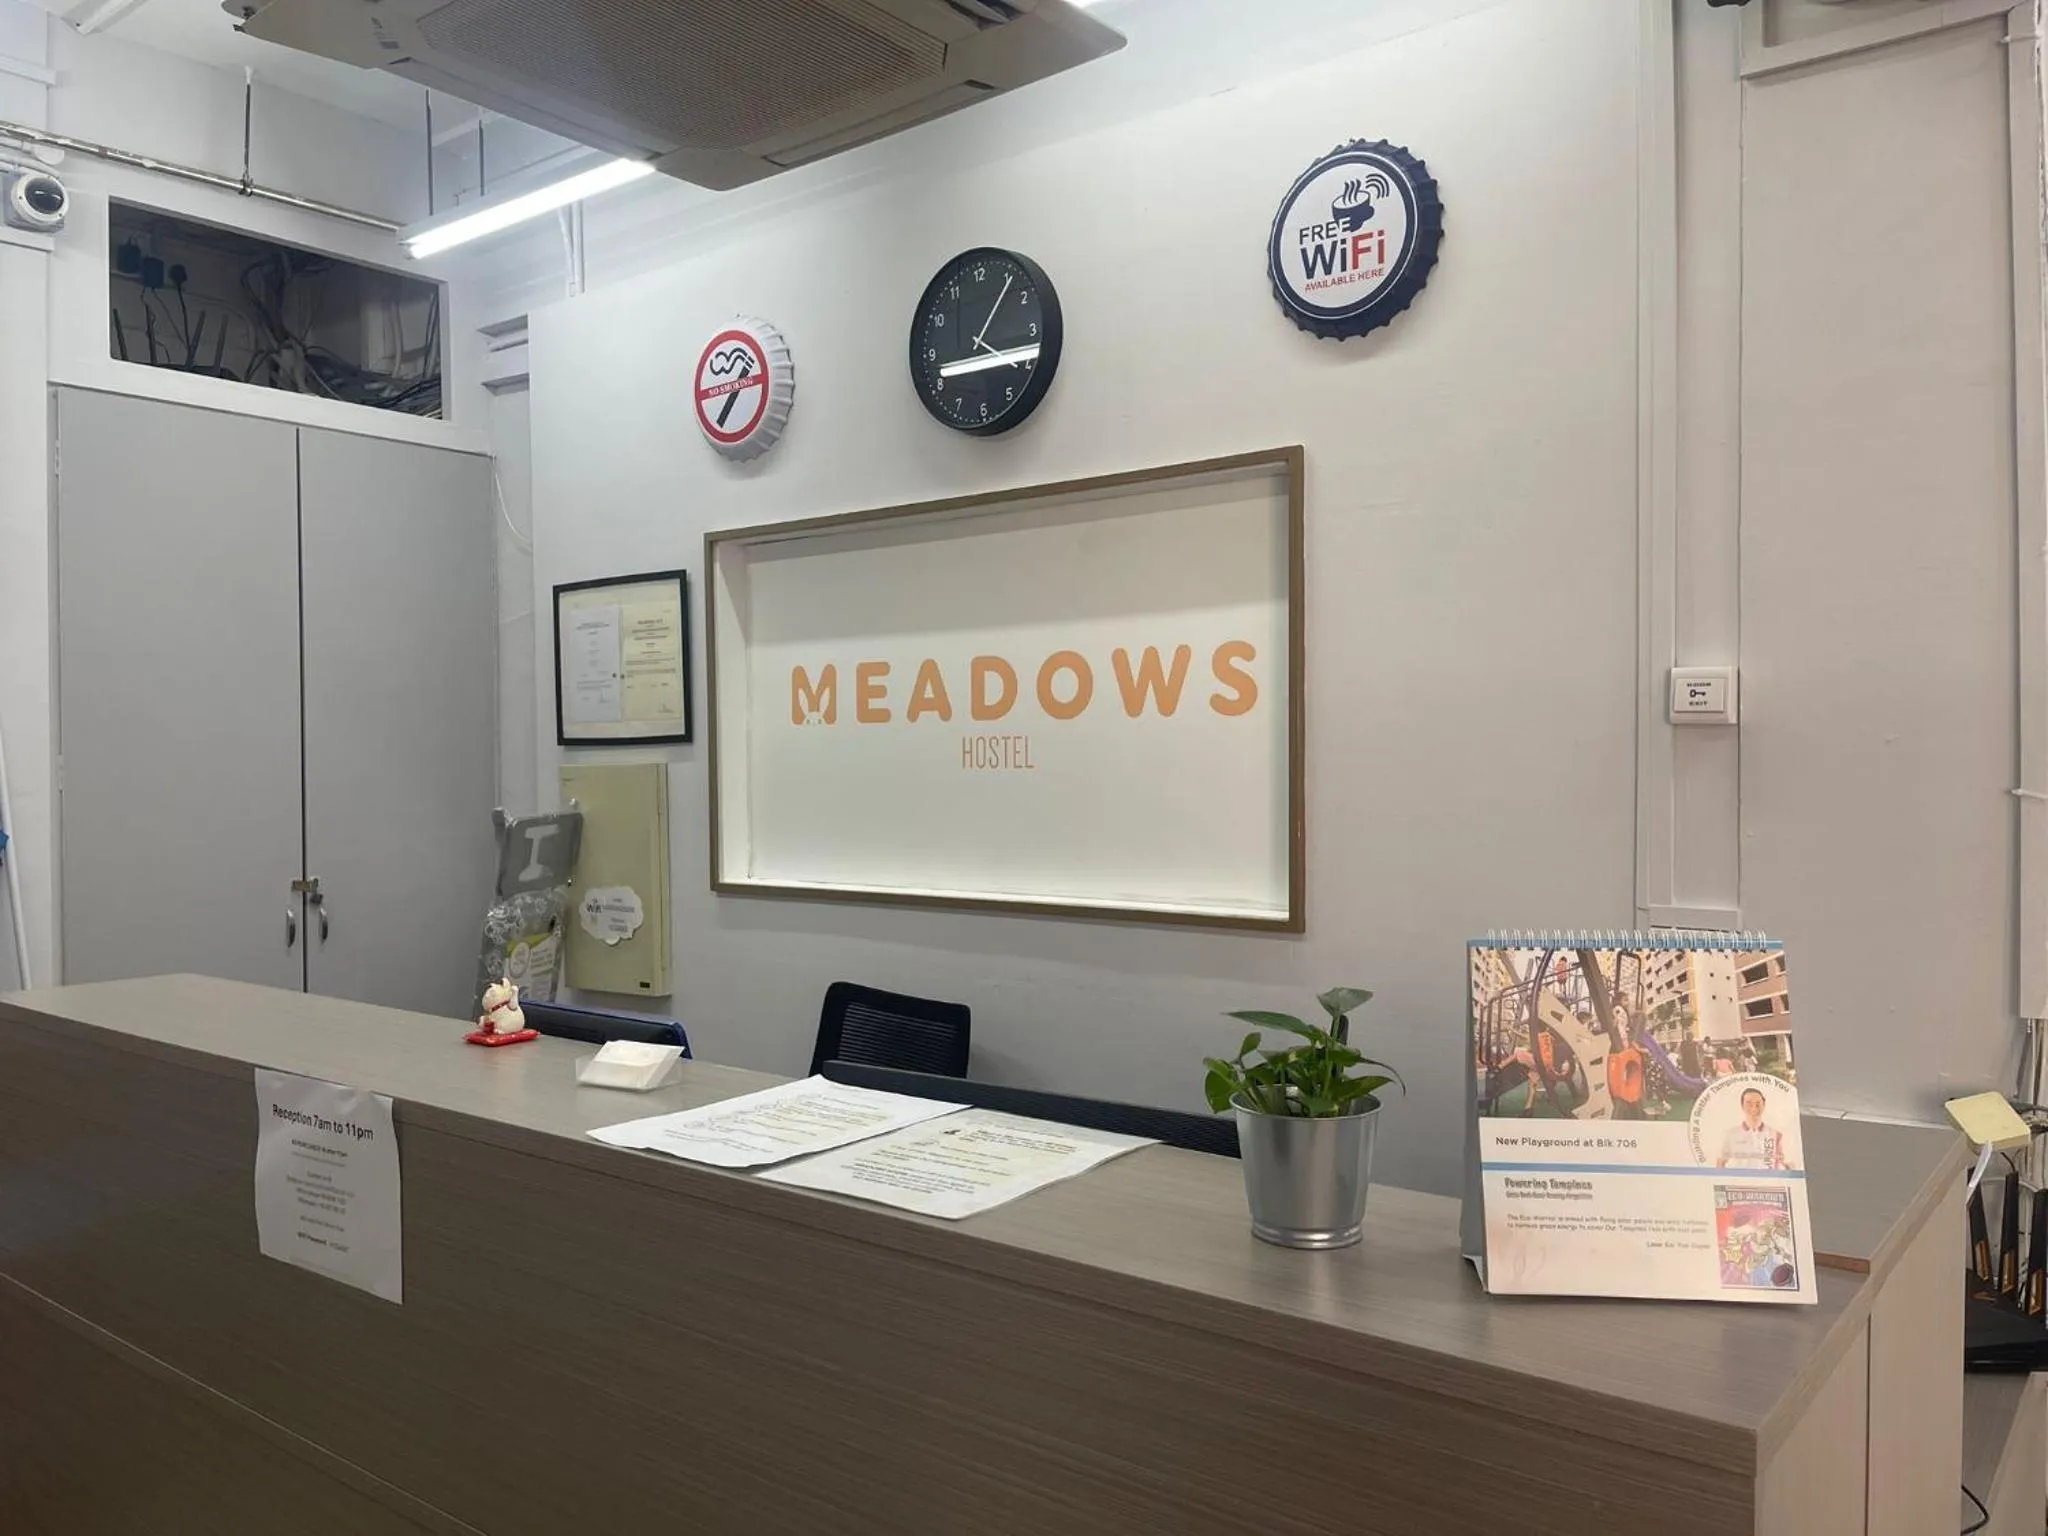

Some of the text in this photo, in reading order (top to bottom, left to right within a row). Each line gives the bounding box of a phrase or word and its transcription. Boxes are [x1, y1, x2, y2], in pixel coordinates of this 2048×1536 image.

[1299, 217, 1351, 245] FREE
[1300, 229, 1385, 280] WiFi
[973, 268, 986, 282] 12
[1304, 268, 1385, 292] AVAILABLE HERE
[950, 286, 960, 299] 11
[1021, 291, 1028, 305] 2
[934, 313, 945, 327] 10
[1029, 323, 1037, 337] 3
[929, 348, 936, 361] 9
[708, 377, 753, 396] NO SMOKING
[937, 378, 944, 391] 8
[1006, 387, 1013, 400] 5
[955, 398, 962, 411] 7
[980, 403, 987, 416] 6
[791, 640, 1259, 726] MEADOWS
[961, 735, 1035, 770] HOSTEL
[1751, 1075, 1772, 1084] with
[1774, 1079, 1791, 1093] You
[272, 1103, 374, 1141] Reception 7am to 11pm
[1495, 1137, 1638, 1149] New Playground at Blk 706
